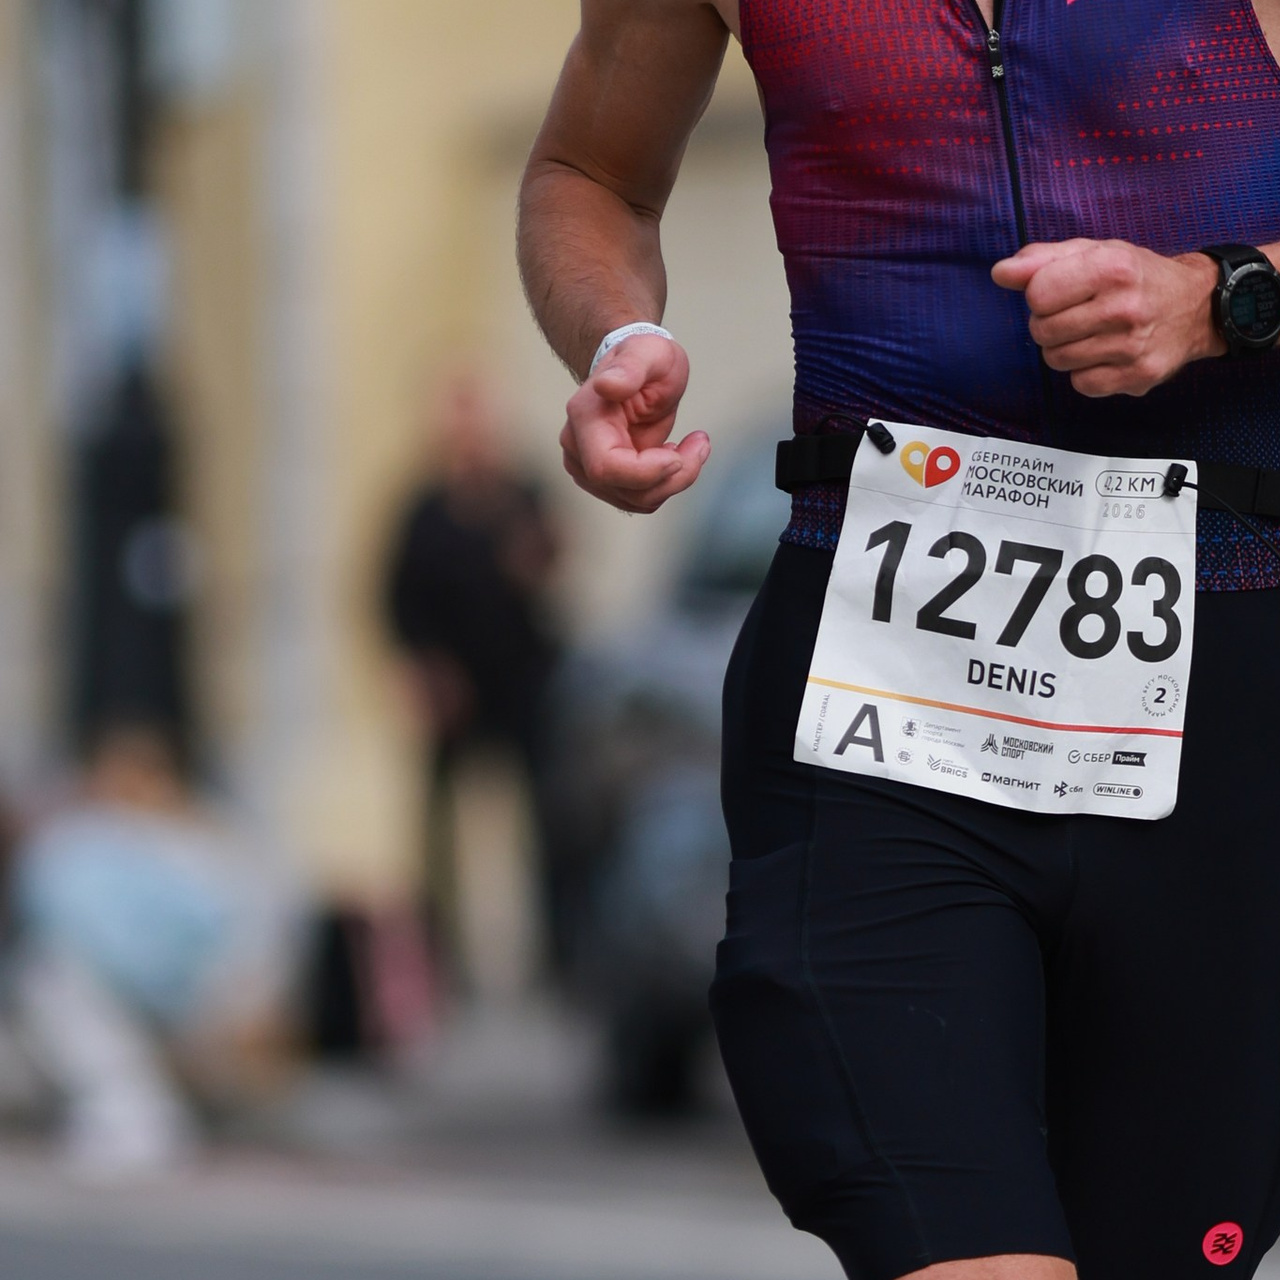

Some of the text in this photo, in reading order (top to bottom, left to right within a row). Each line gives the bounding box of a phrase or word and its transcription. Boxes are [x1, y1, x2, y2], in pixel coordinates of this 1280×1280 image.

[971, 451, 1054, 474] СБЕРПРАЙМ
[965, 465, 1084, 497] МОСКОВСКИЙ
[960, 482, 1050, 508] МАРАФОН
[1102, 502, 1146, 519] 2026
[864, 520, 1182, 663] 12783
[967, 658, 1057, 698] DENIS
[1153, 687, 1167, 704] 2
[1001, 746, 1025, 760] СПОРТ
[1002, 736, 1054, 755] МОСКОВСКИЙ
[1083, 752, 1141, 764] СБЕР Прайм
[940, 766, 968, 779] BRICS
[992, 774, 1042, 791] магнит
[1096, 785, 1132, 796] WINLINE
